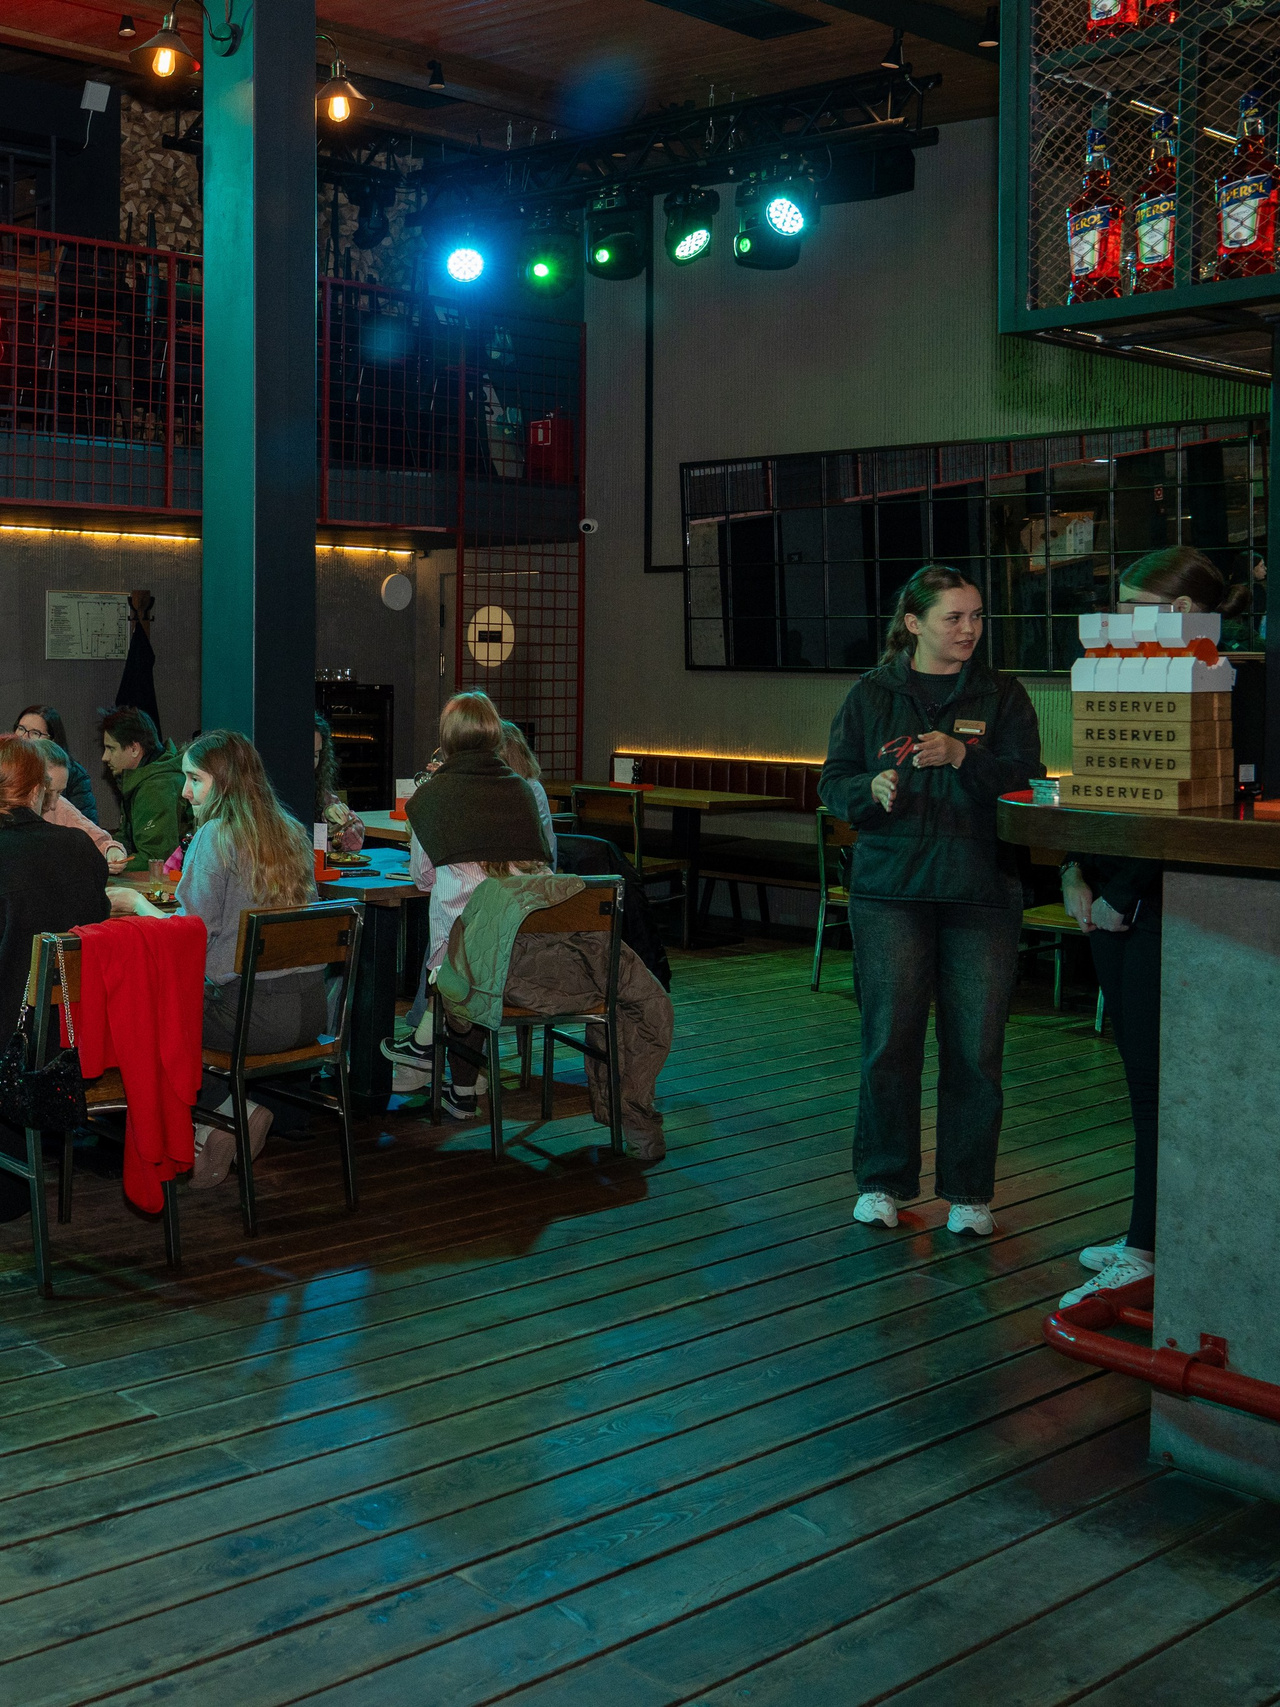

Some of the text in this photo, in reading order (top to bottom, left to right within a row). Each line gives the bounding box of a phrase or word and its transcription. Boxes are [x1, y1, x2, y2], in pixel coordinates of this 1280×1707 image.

[1219, 181, 1266, 208] APEROL
[1135, 200, 1176, 223] APEROL
[1086, 700, 1177, 714] RESERVED
[1085, 728, 1176, 742] RESERVED
[1085, 756, 1176, 770] RESERVED
[1072, 785, 1164, 800] RESERVED
